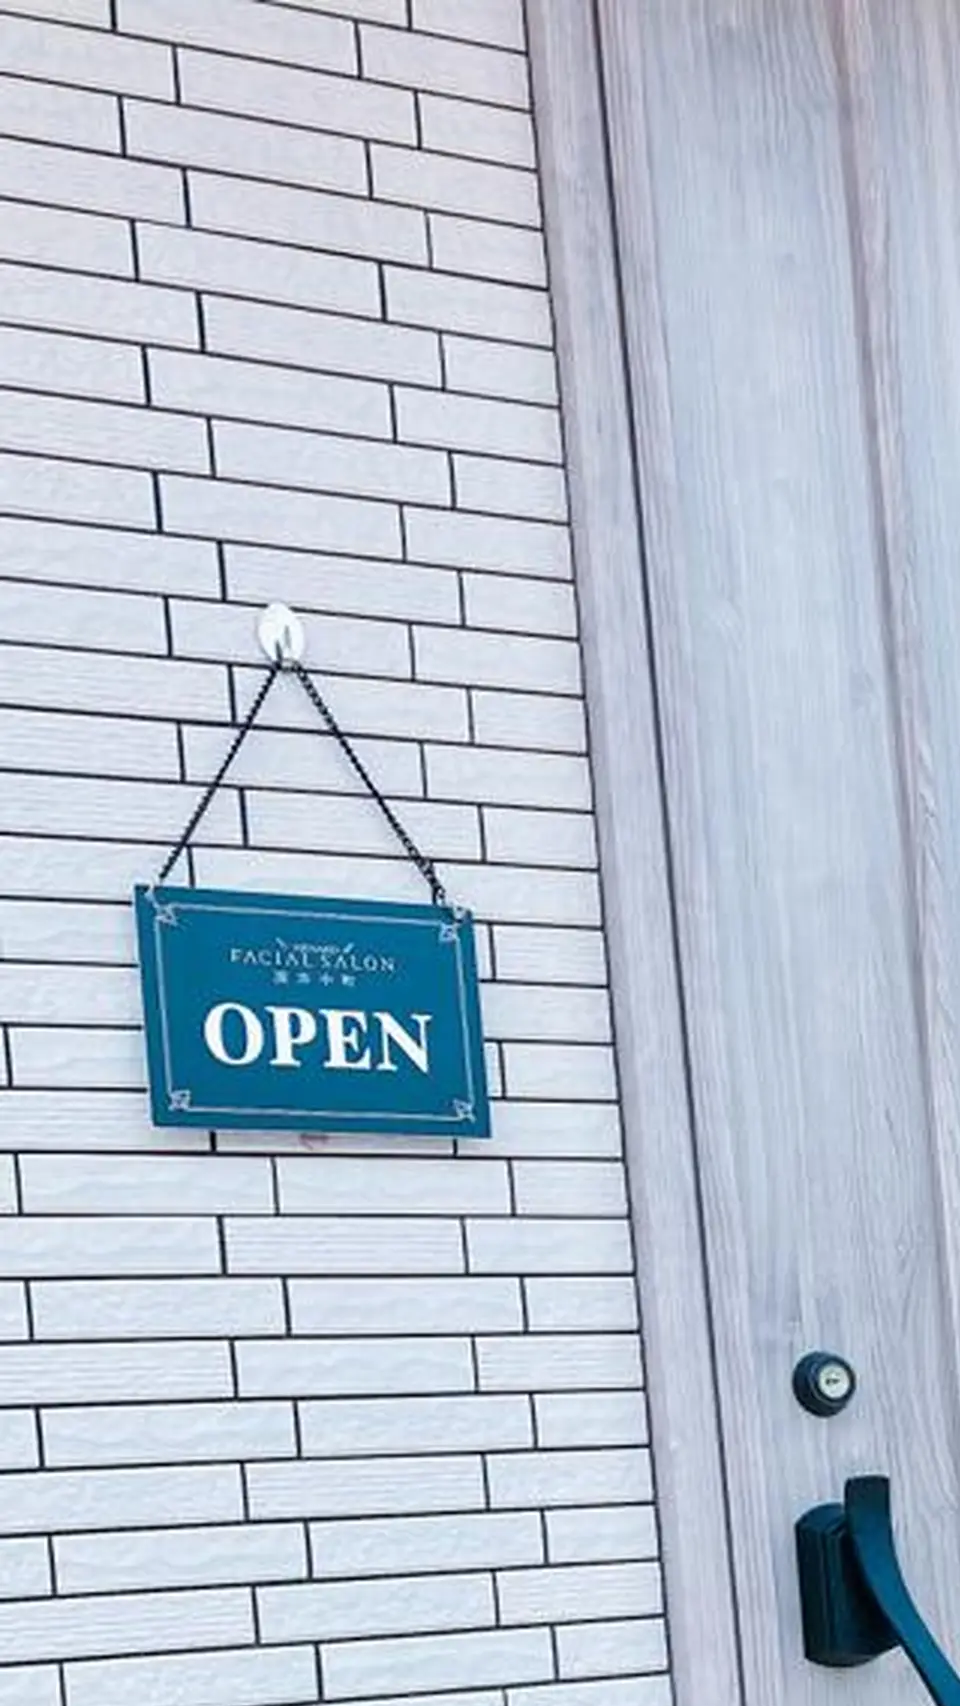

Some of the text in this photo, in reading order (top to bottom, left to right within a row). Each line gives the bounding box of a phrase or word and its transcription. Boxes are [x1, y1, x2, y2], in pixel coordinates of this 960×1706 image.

[230, 947, 313, 970] FACIAL
[319, 951, 396, 974] SALON
[203, 1001, 433, 1075] OPEN
